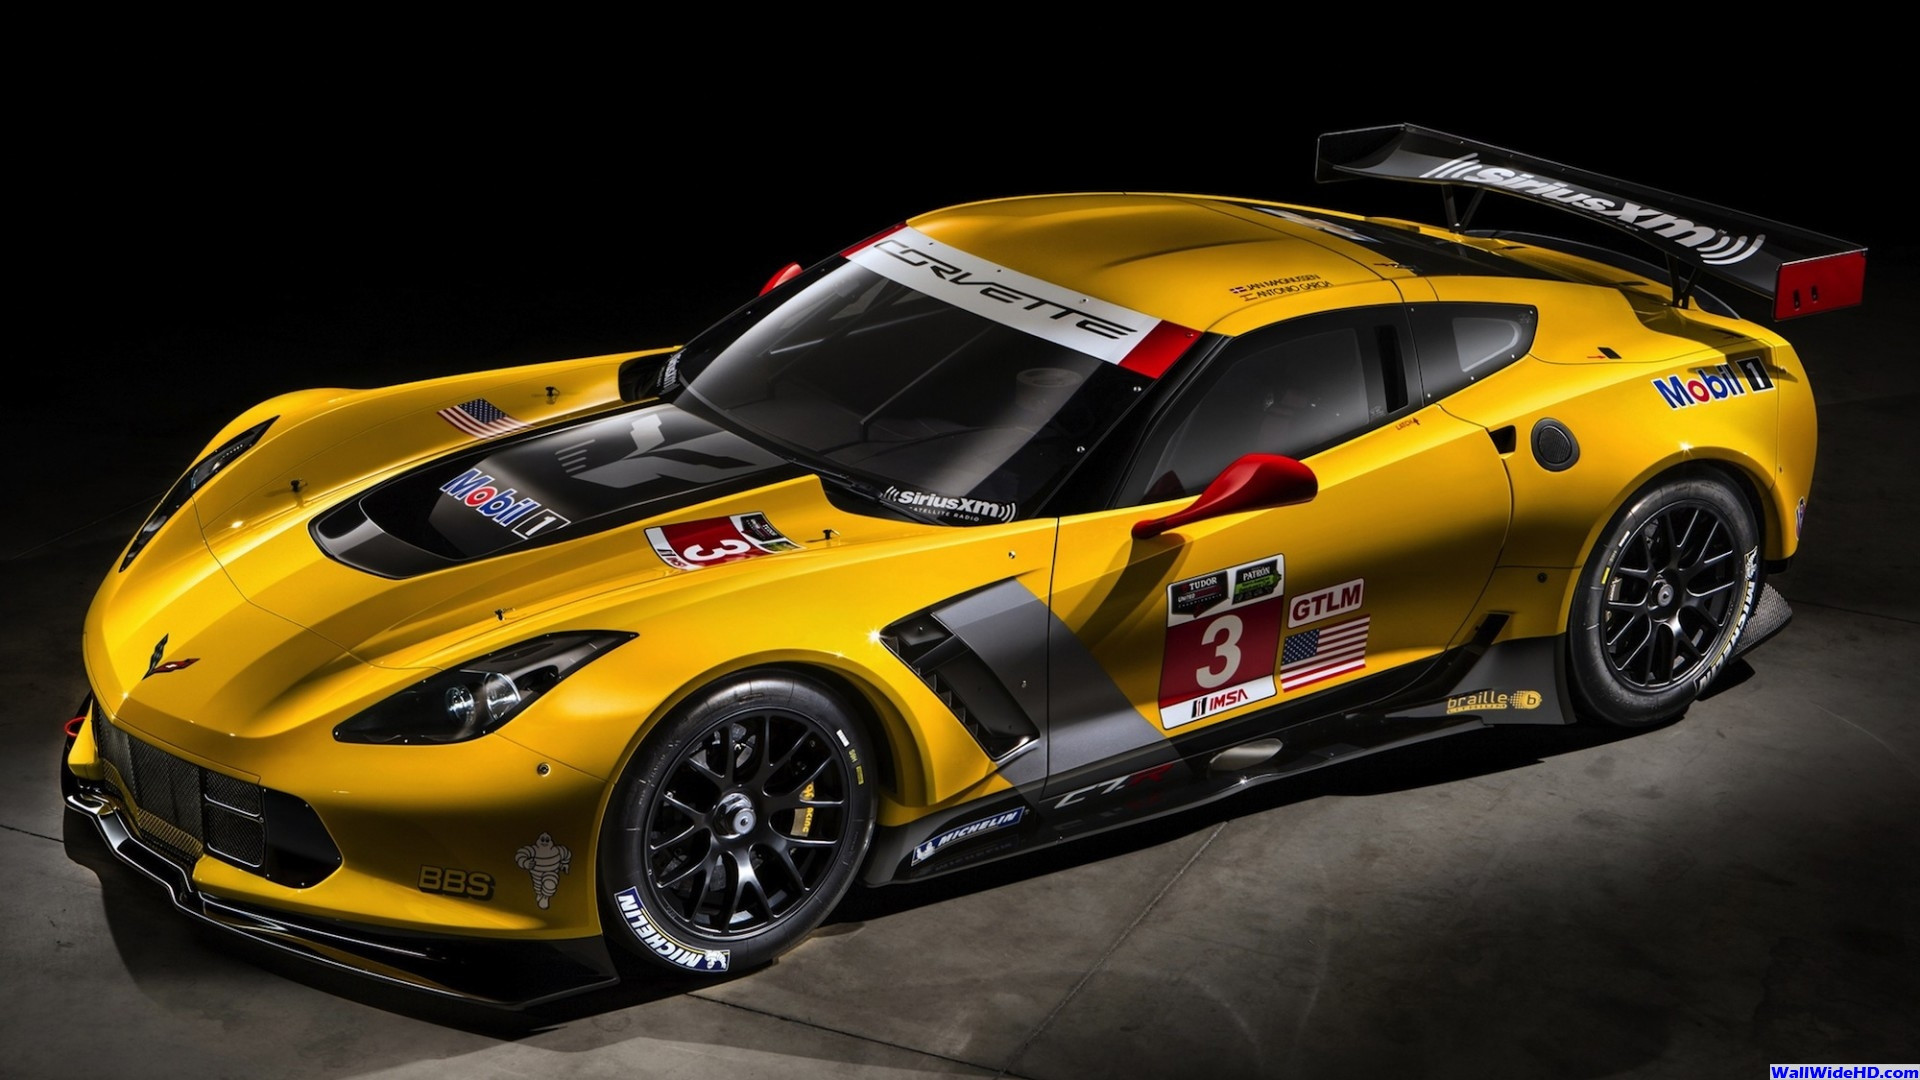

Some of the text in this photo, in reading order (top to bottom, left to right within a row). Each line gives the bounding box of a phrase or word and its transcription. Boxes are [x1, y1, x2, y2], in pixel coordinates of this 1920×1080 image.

[873, 239, 1138, 340] CORVETTE
[1256, 284, 1299, 298] ANTONIO
[1650, 361, 1746, 411] Mobil
[440, 467, 541, 528] Mobil
[683, 539, 751, 561] 3
[1189, 576, 1218, 591] TUDOR
[1292, 583, 1361, 621] GTLM
[1195, 614, 1243, 689] 3
[1699, 580, 1756, 690] MICHELIN
[1209, 688, 1248, 711] IMSA
[1447, 690, 1508, 709] braille
[936, 810, 1018, 848] MICHELIN
[417, 864, 495, 901] BBS
[617, 894, 704, 968] MICHELIN
